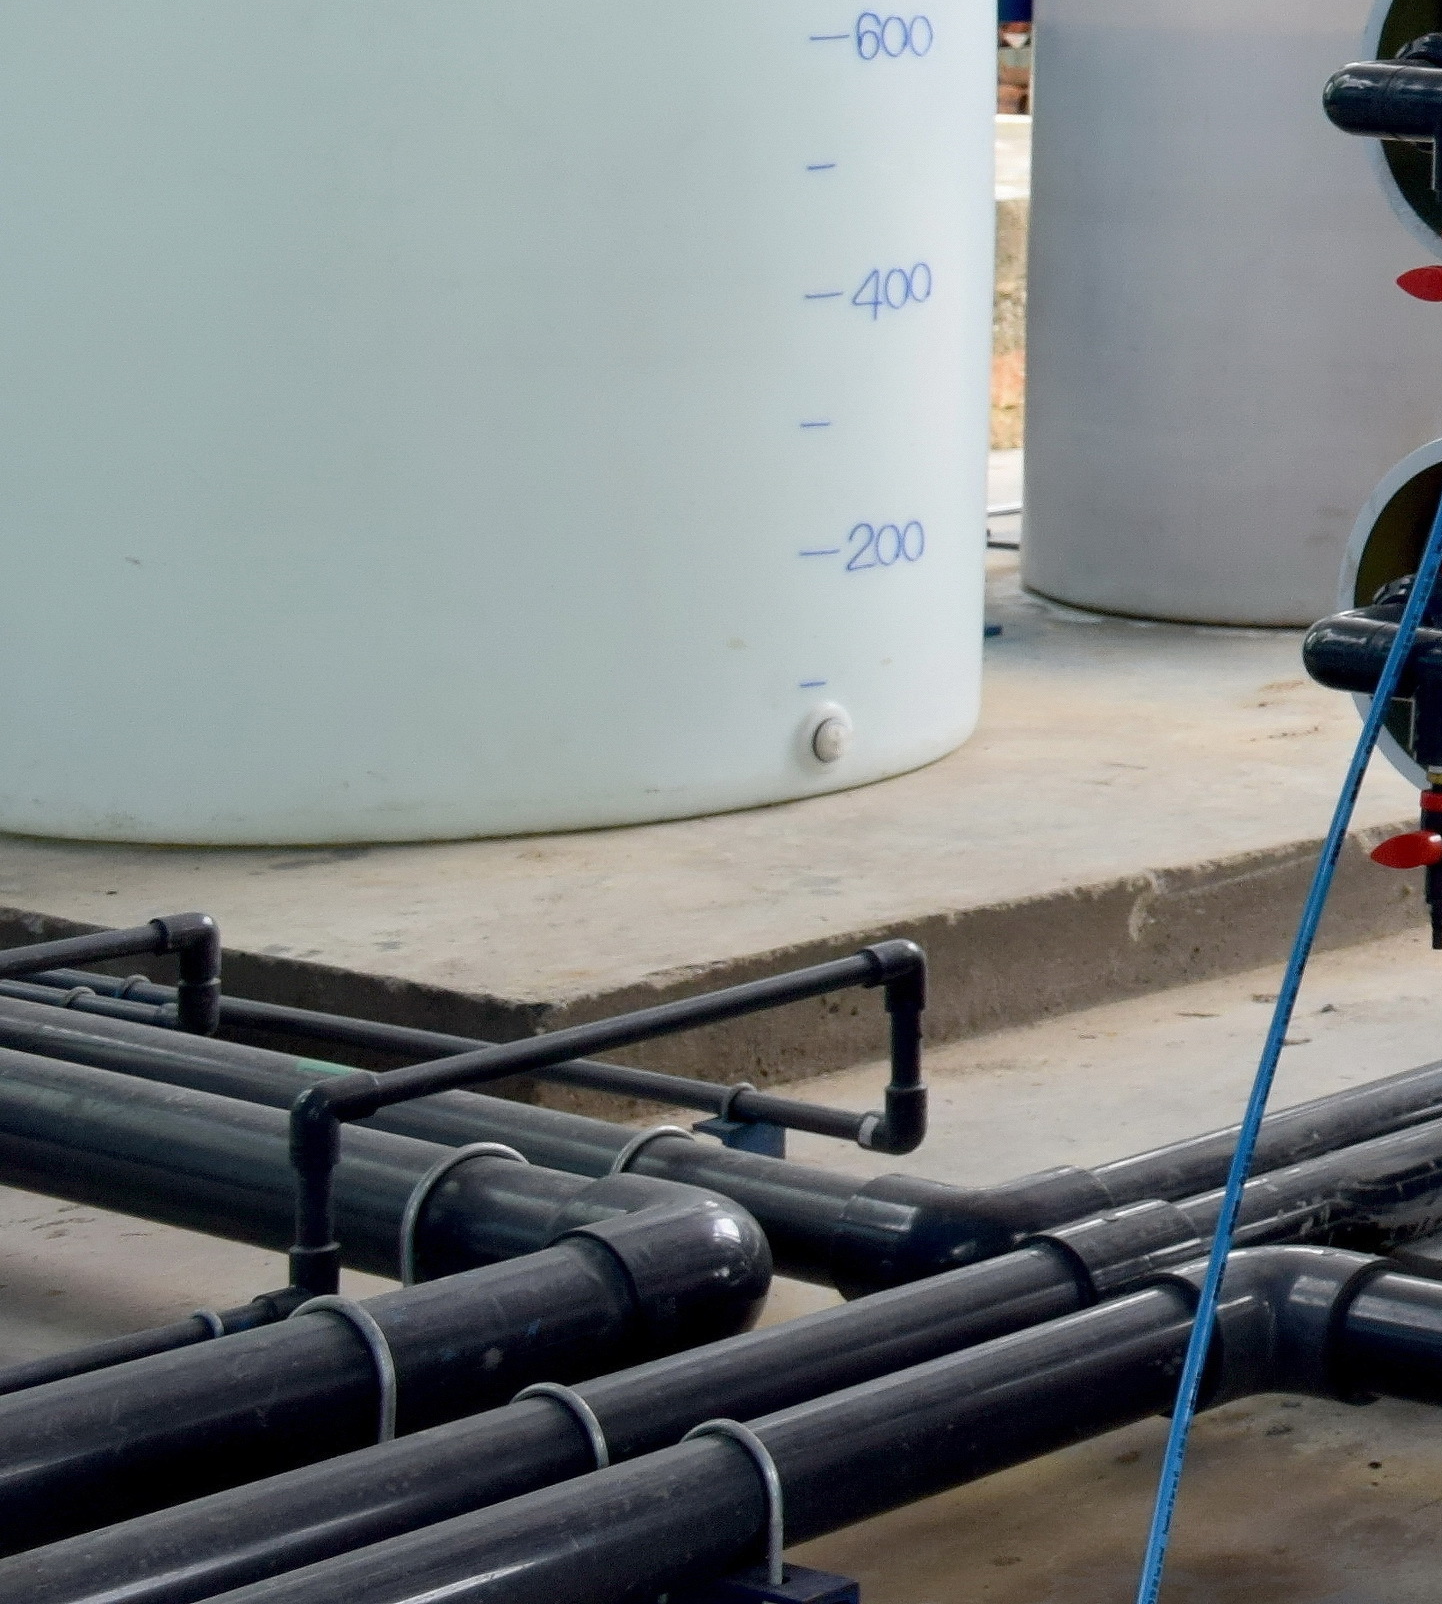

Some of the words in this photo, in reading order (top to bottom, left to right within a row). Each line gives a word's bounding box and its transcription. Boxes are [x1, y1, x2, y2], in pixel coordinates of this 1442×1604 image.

[857, 12, 934, 60] 600
[852, 262, 931, 320] 400
[847, 521, 925, 571] 200
